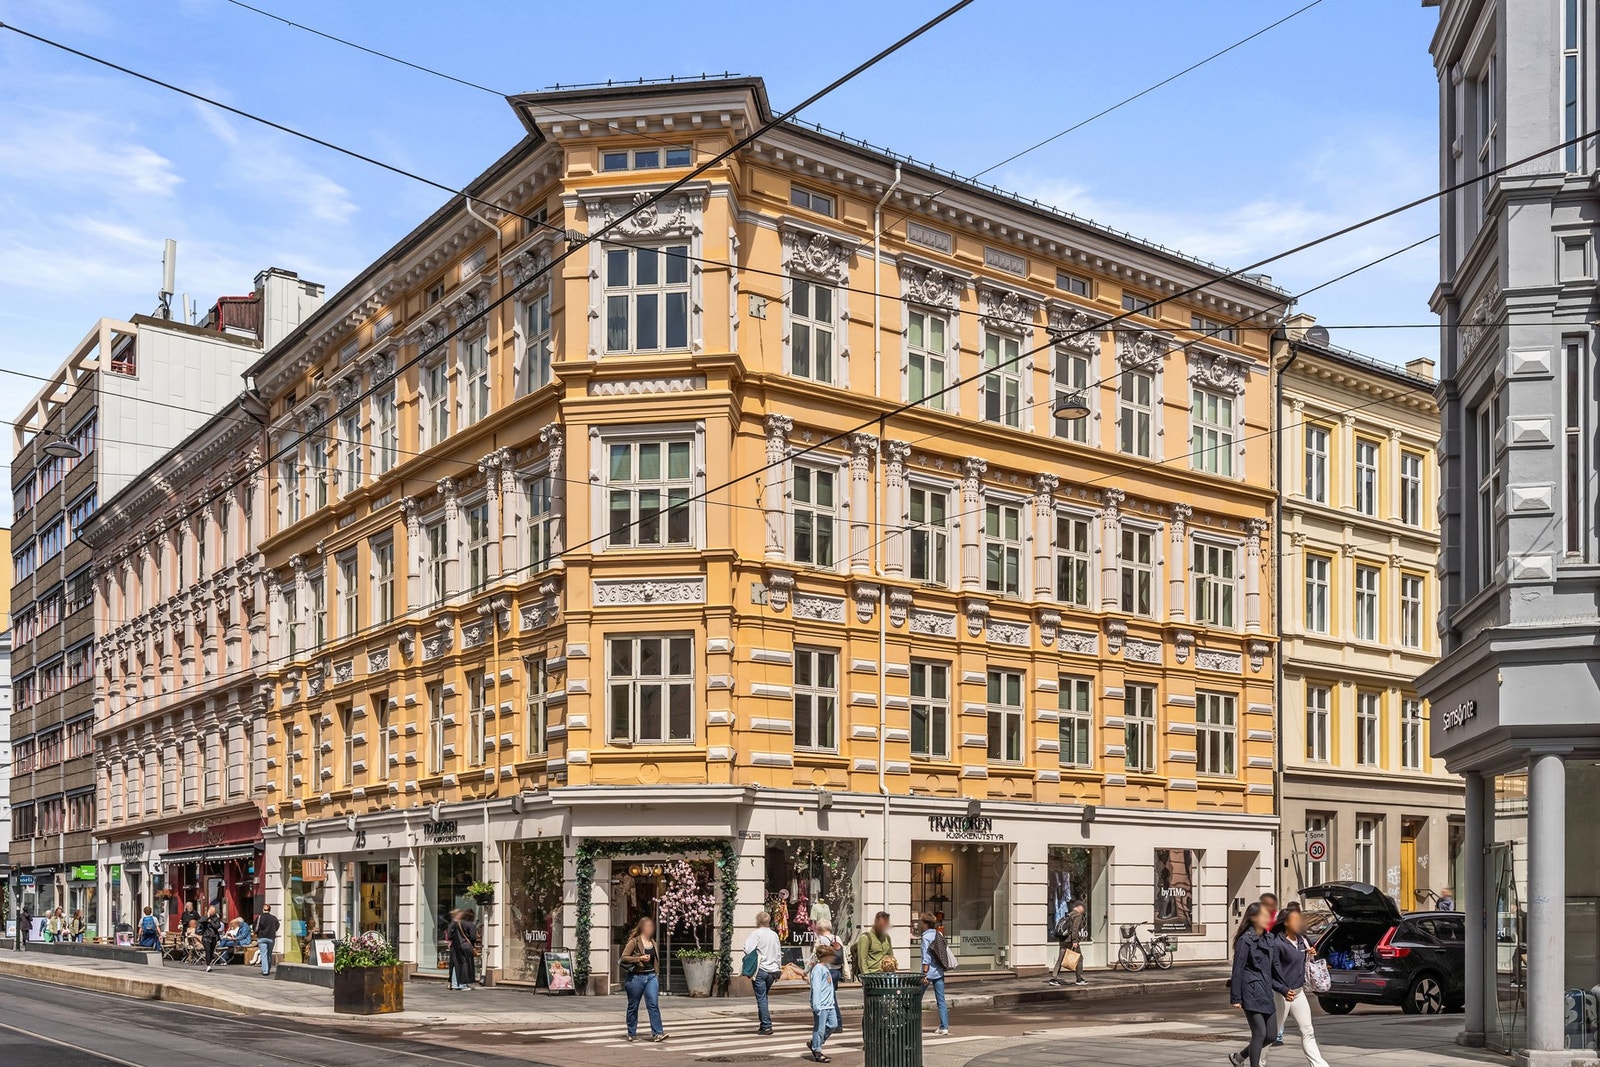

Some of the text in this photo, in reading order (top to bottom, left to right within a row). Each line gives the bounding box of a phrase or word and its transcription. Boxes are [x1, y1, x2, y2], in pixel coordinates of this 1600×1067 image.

[928, 816, 992, 831] TRAKTØREN
[356, 830, 366, 848] 25
[946, 832, 1004, 840] KJØKKENUTSTYR
[1312, 845, 1322, 855] 30
[1161, 887, 1186, 899] byTiMo
[525, 930, 547, 943] byTiMo
